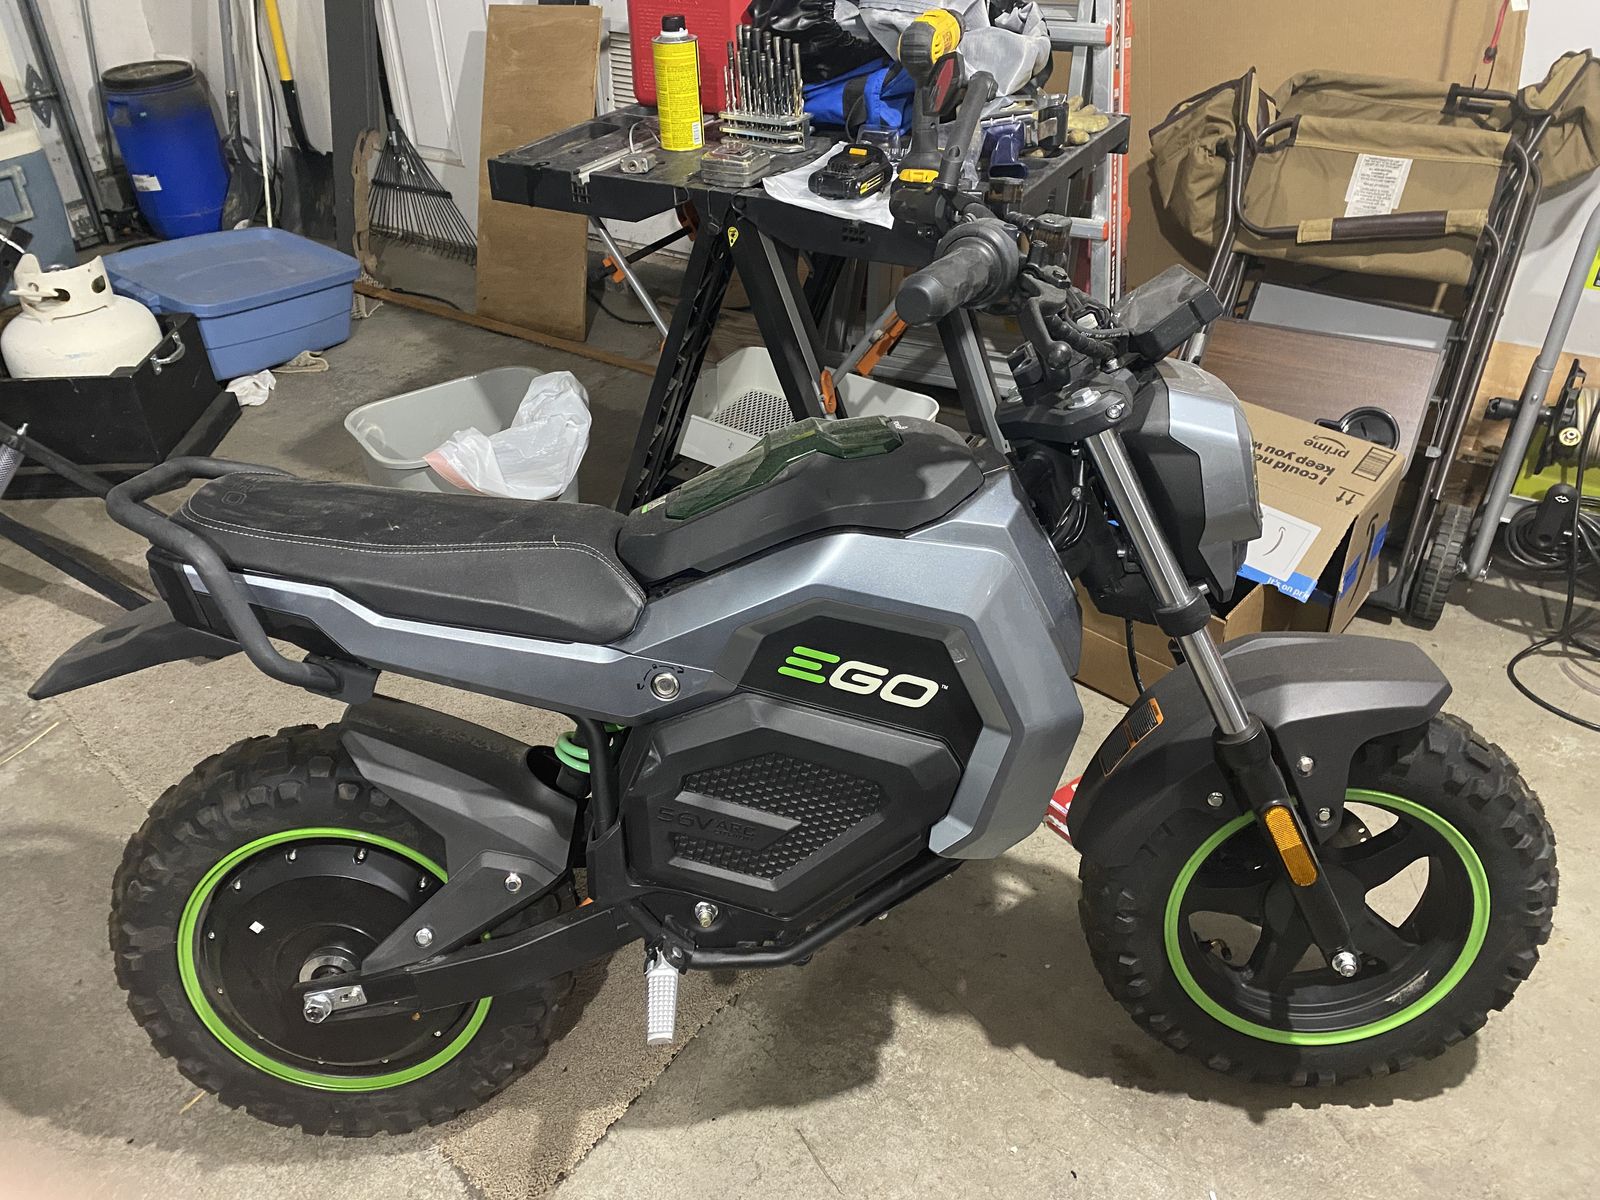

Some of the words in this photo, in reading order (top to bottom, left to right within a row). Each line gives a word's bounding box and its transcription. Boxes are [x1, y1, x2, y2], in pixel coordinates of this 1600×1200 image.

[1264, 444, 1296, 461] you
[1303, 438, 1350, 458] prime
[1272, 461, 1319, 481] could
[1295, 456, 1336, 476] keep
[1281, 584, 1293, 593] on
[777, 645, 940, 708] EGO
